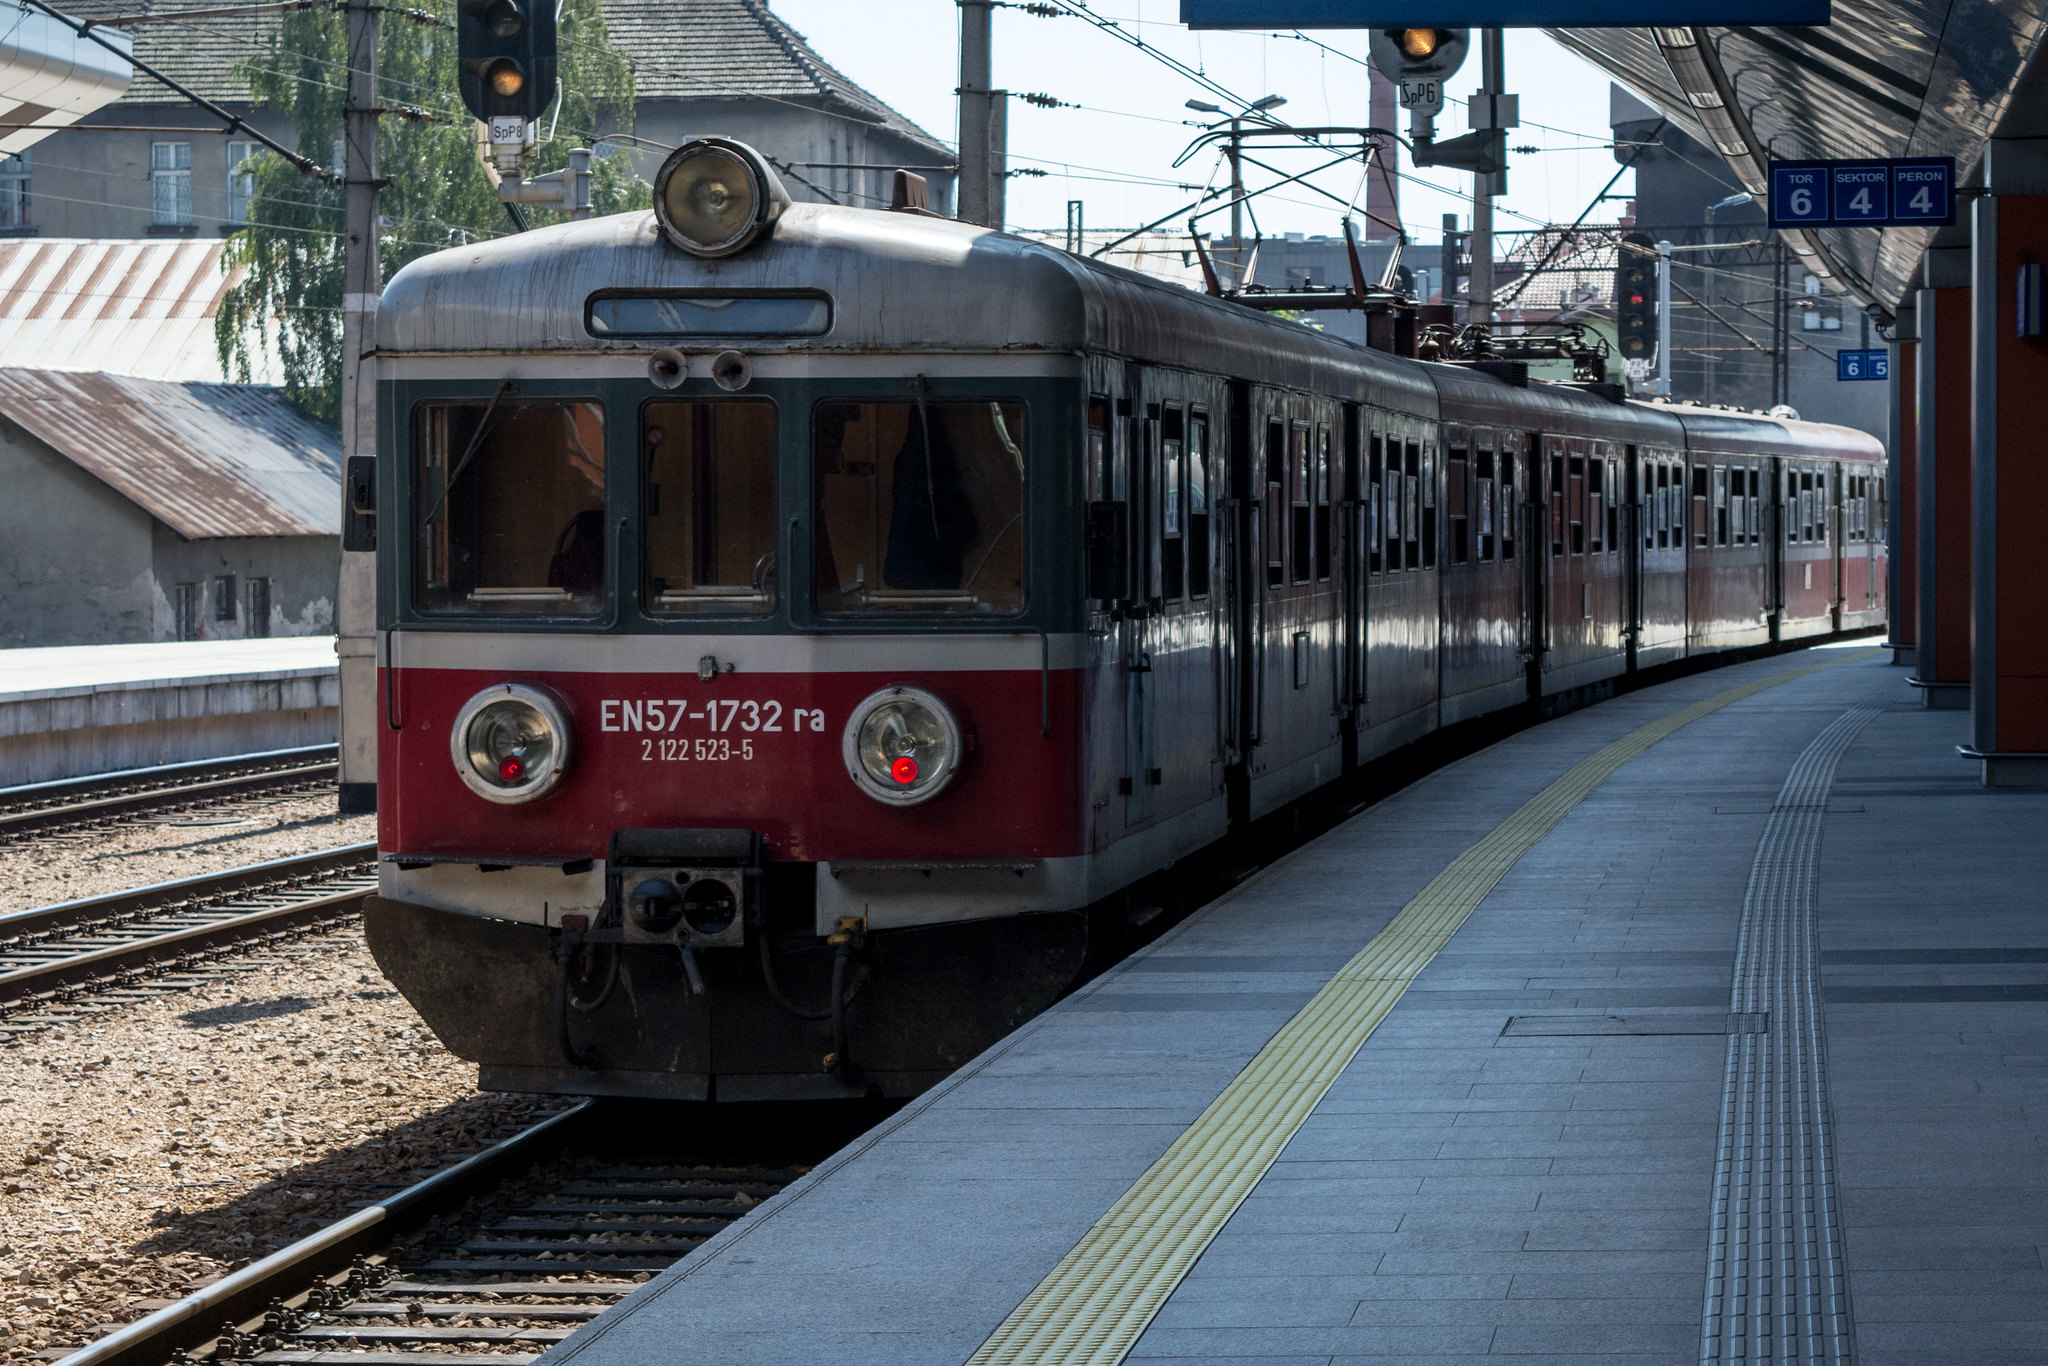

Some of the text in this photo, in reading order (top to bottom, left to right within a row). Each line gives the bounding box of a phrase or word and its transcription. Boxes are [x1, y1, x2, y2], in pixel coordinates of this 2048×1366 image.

[1402, 83, 1435, 105] SpP6
[494, 125, 523, 141] SpP8
[1788, 172, 1943, 184] TOR SEKTOR PERON
[1790, 186, 1933, 216] 6 4 4
[1848, 362, 1887, 376] 6 5
[601, 699, 825, 732] EN57-1732 ra
[641, 738, 754, 761] 2 122 523-5
